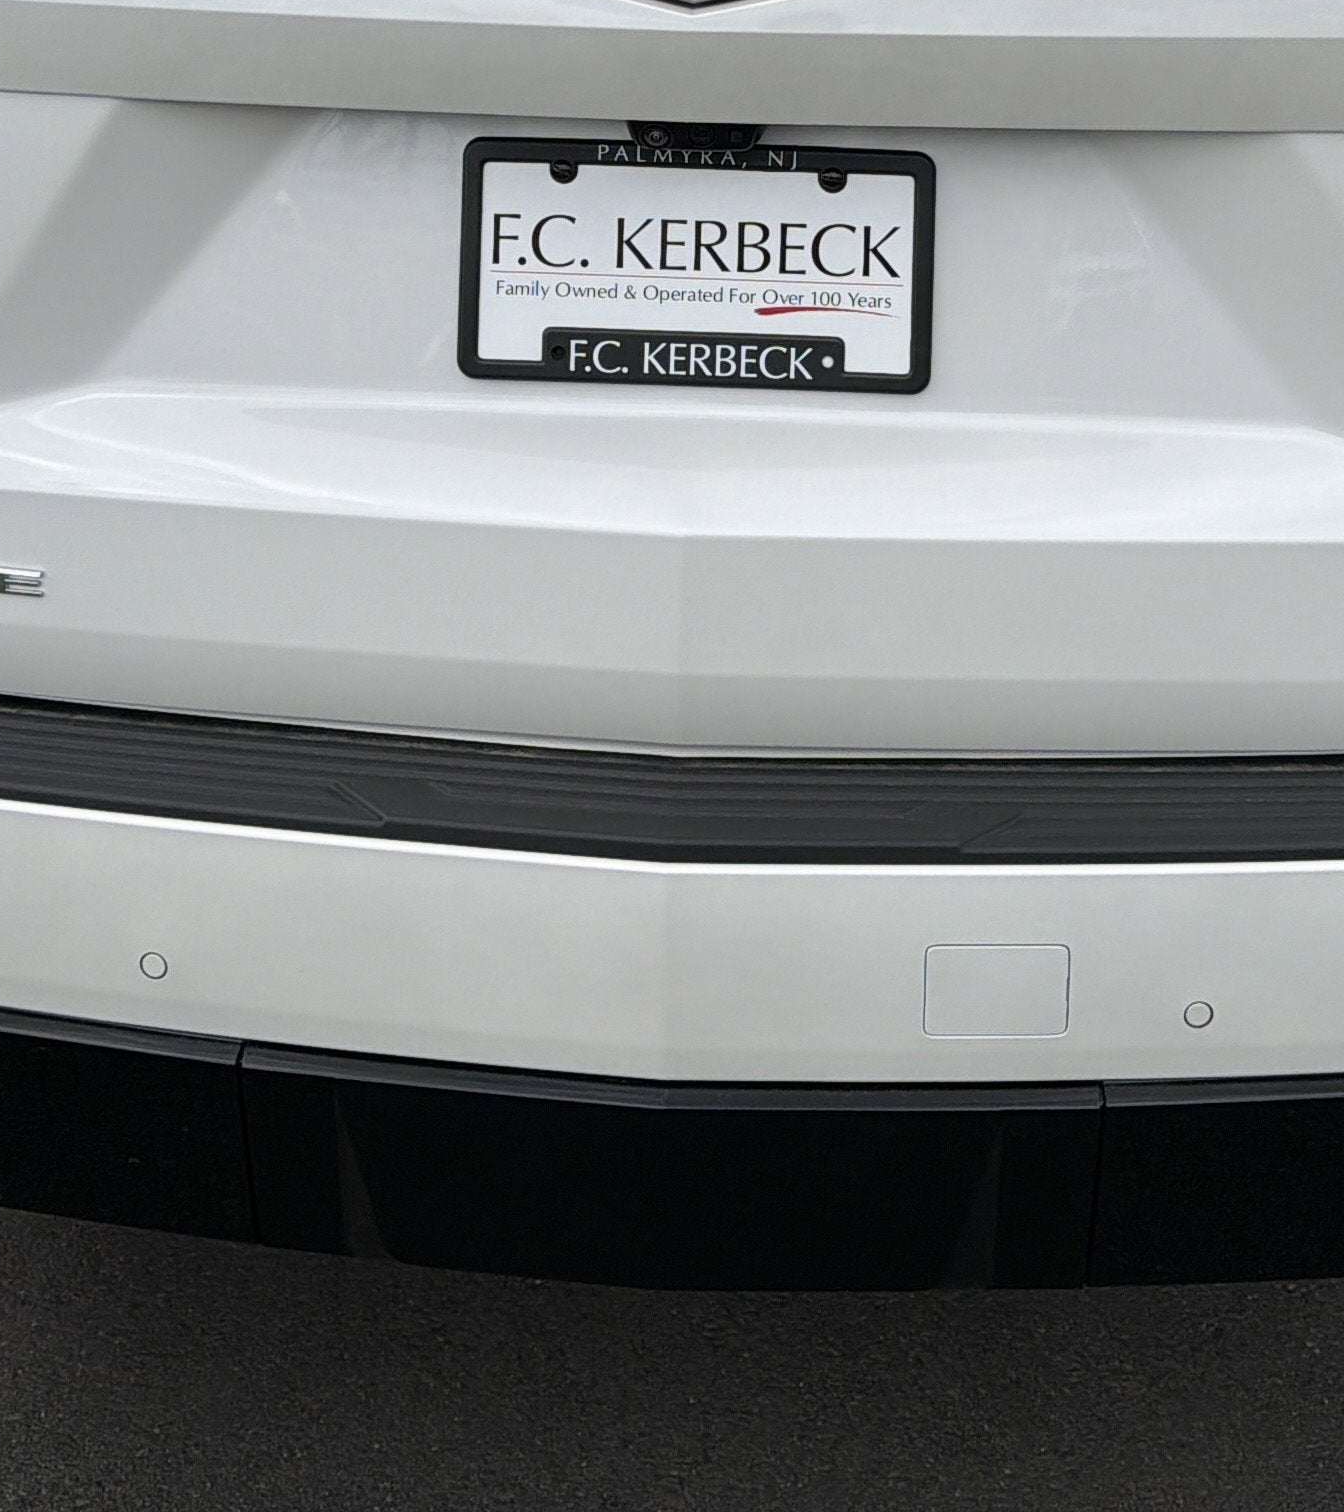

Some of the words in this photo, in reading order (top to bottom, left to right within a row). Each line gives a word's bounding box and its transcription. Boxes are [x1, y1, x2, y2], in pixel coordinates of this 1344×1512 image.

[597, 144, 748, 168] PALMYRA,
[768, 151, 799, 171] NJ
[491, 213, 590, 268] F.C.
[616, 217, 901, 279] KERBECK
[496, 280, 550, 301] Family
[555, 282, 619, 301] Owned
[624, 284, 638, 301] &
[643, 285, 724, 307] Operated
[729, 288, 757, 304] For
[762, 289, 804, 307] Over
[810, 291, 842, 307] 100
[848, 292, 893, 310] Years
[569, 339, 629, 374] F.C.
[643, 341, 814, 381] KERBECK
